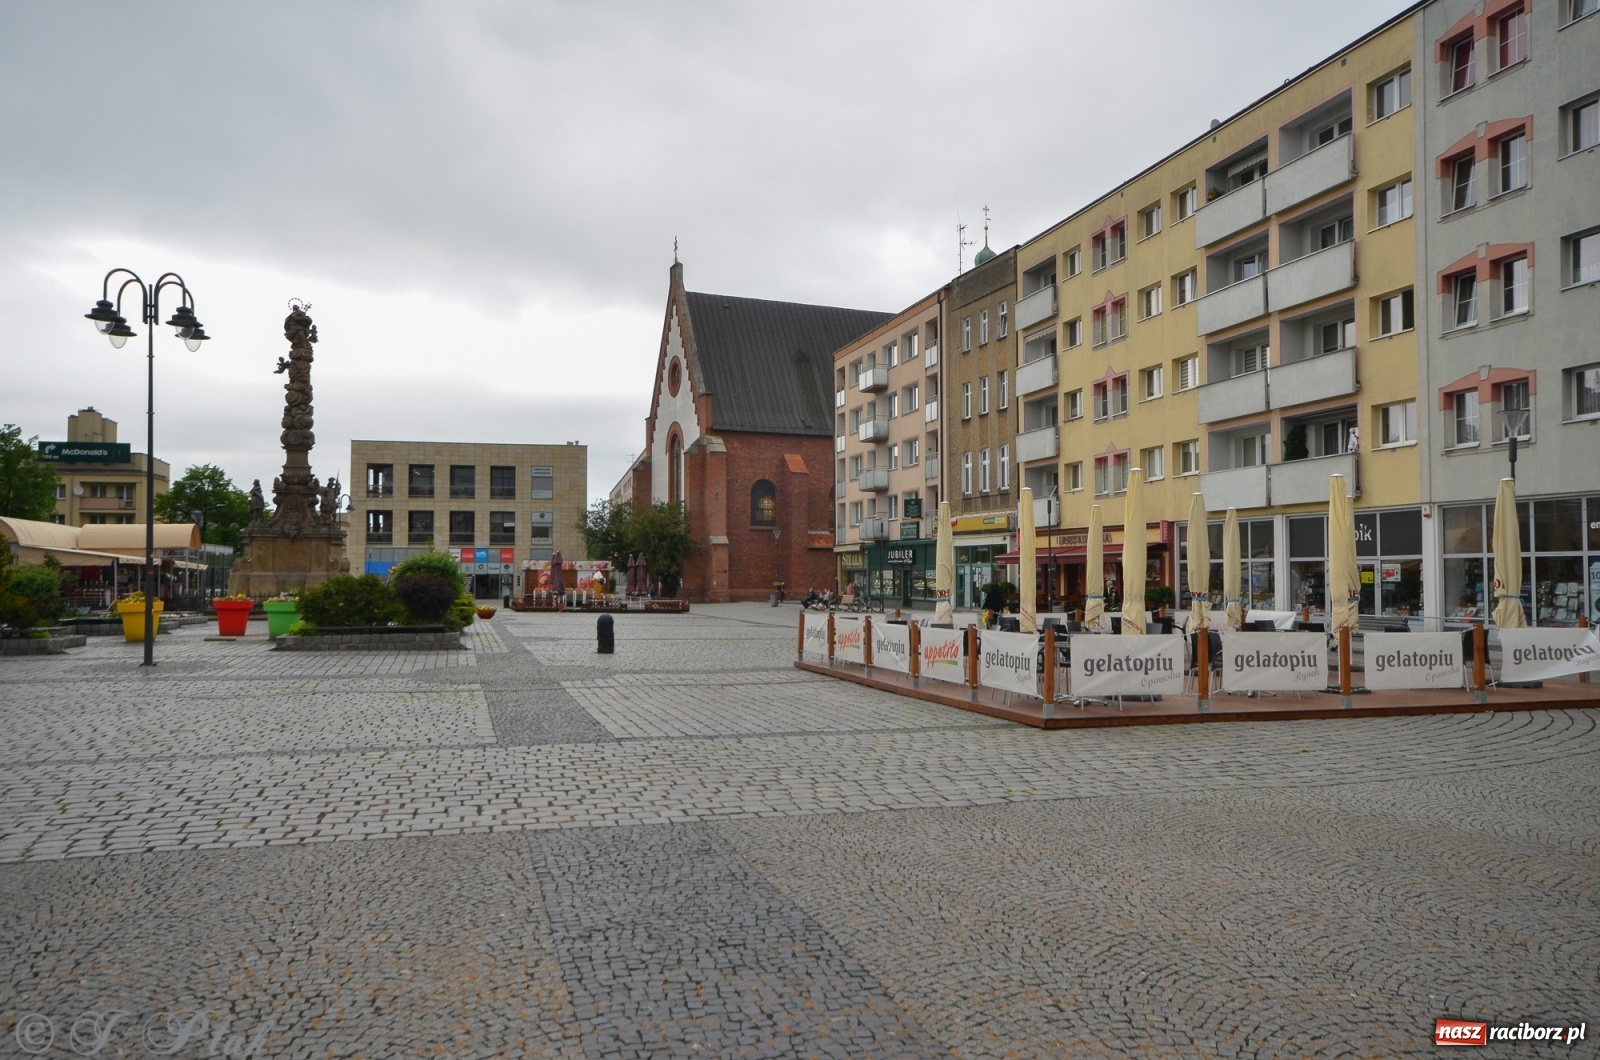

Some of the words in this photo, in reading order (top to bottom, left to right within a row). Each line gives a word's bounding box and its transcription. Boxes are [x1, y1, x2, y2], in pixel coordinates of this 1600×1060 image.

[61, 448, 108, 456] McDonald's
[842, 553, 862, 566] STELLA
[888, 550, 912, 559] JUBILER
[924, 640, 959, 668] appetito
[986, 649, 1030, 673] gelatopiu
[1234, 650, 1318, 672] gelatopiu
[1376, 650, 1454, 671] gelatopiu
[1513, 644, 1596, 665] gelatopiu
[1083, 653, 1173, 677] gelatopiu
[1293, 667, 1320, 682] Rynek
[1140, 671, 1181, 688] Opawska
